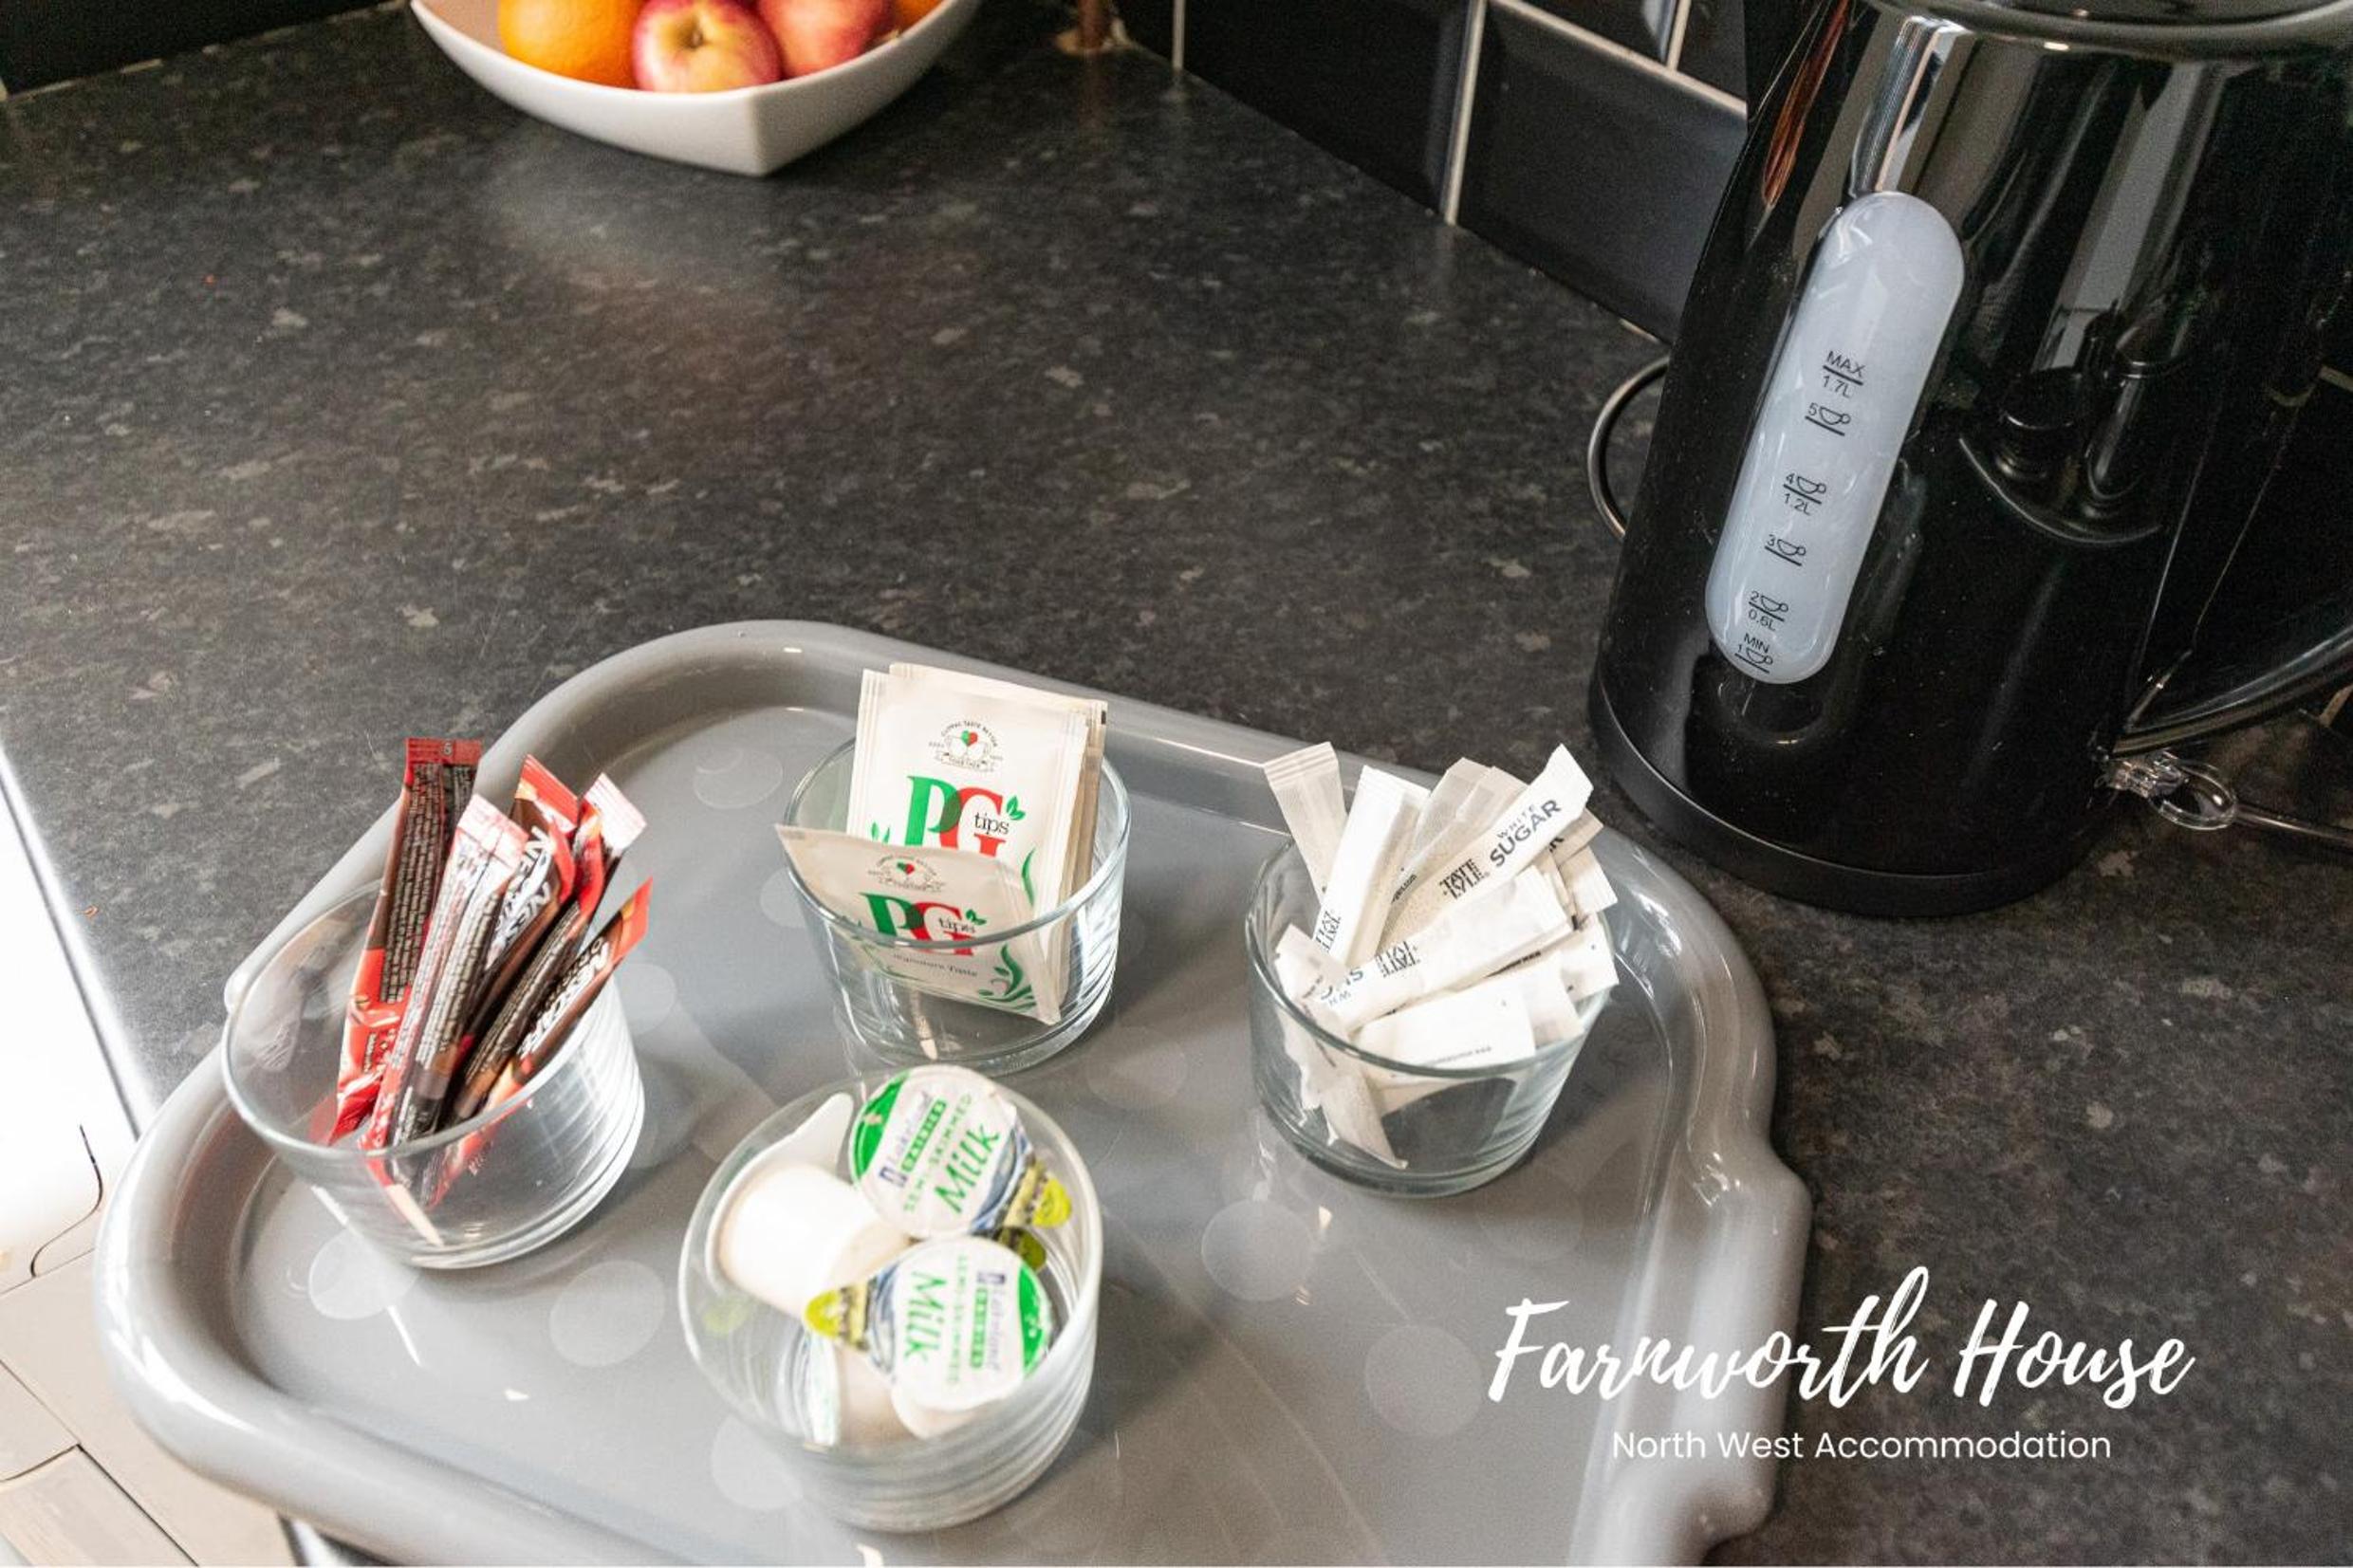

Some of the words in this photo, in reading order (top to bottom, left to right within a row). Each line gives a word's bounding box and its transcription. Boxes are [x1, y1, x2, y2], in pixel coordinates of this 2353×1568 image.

[1826, 350, 1865, 378] MAX
[1823, 377, 1851, 398] 1.7L
[1807, 403, 1817, 416] 5
[1785, 473, 1795, 485] 4
[1767, 534, 1776, 547] 3
[1750, 591, 1760, 604] 2
[1743, 633, 1770, 655] MIN
[906, 775, 1008, 858] PG
[974, 811, 1010, 836] tips
[1490, 799, 1562, 867] SUGAR
[861, 892, 975, 957] PG
[939, 916, 976, 934] tips
[934, 1122, 1001, 1213] Milk
[903, 1270, 949, 1365] Milk
